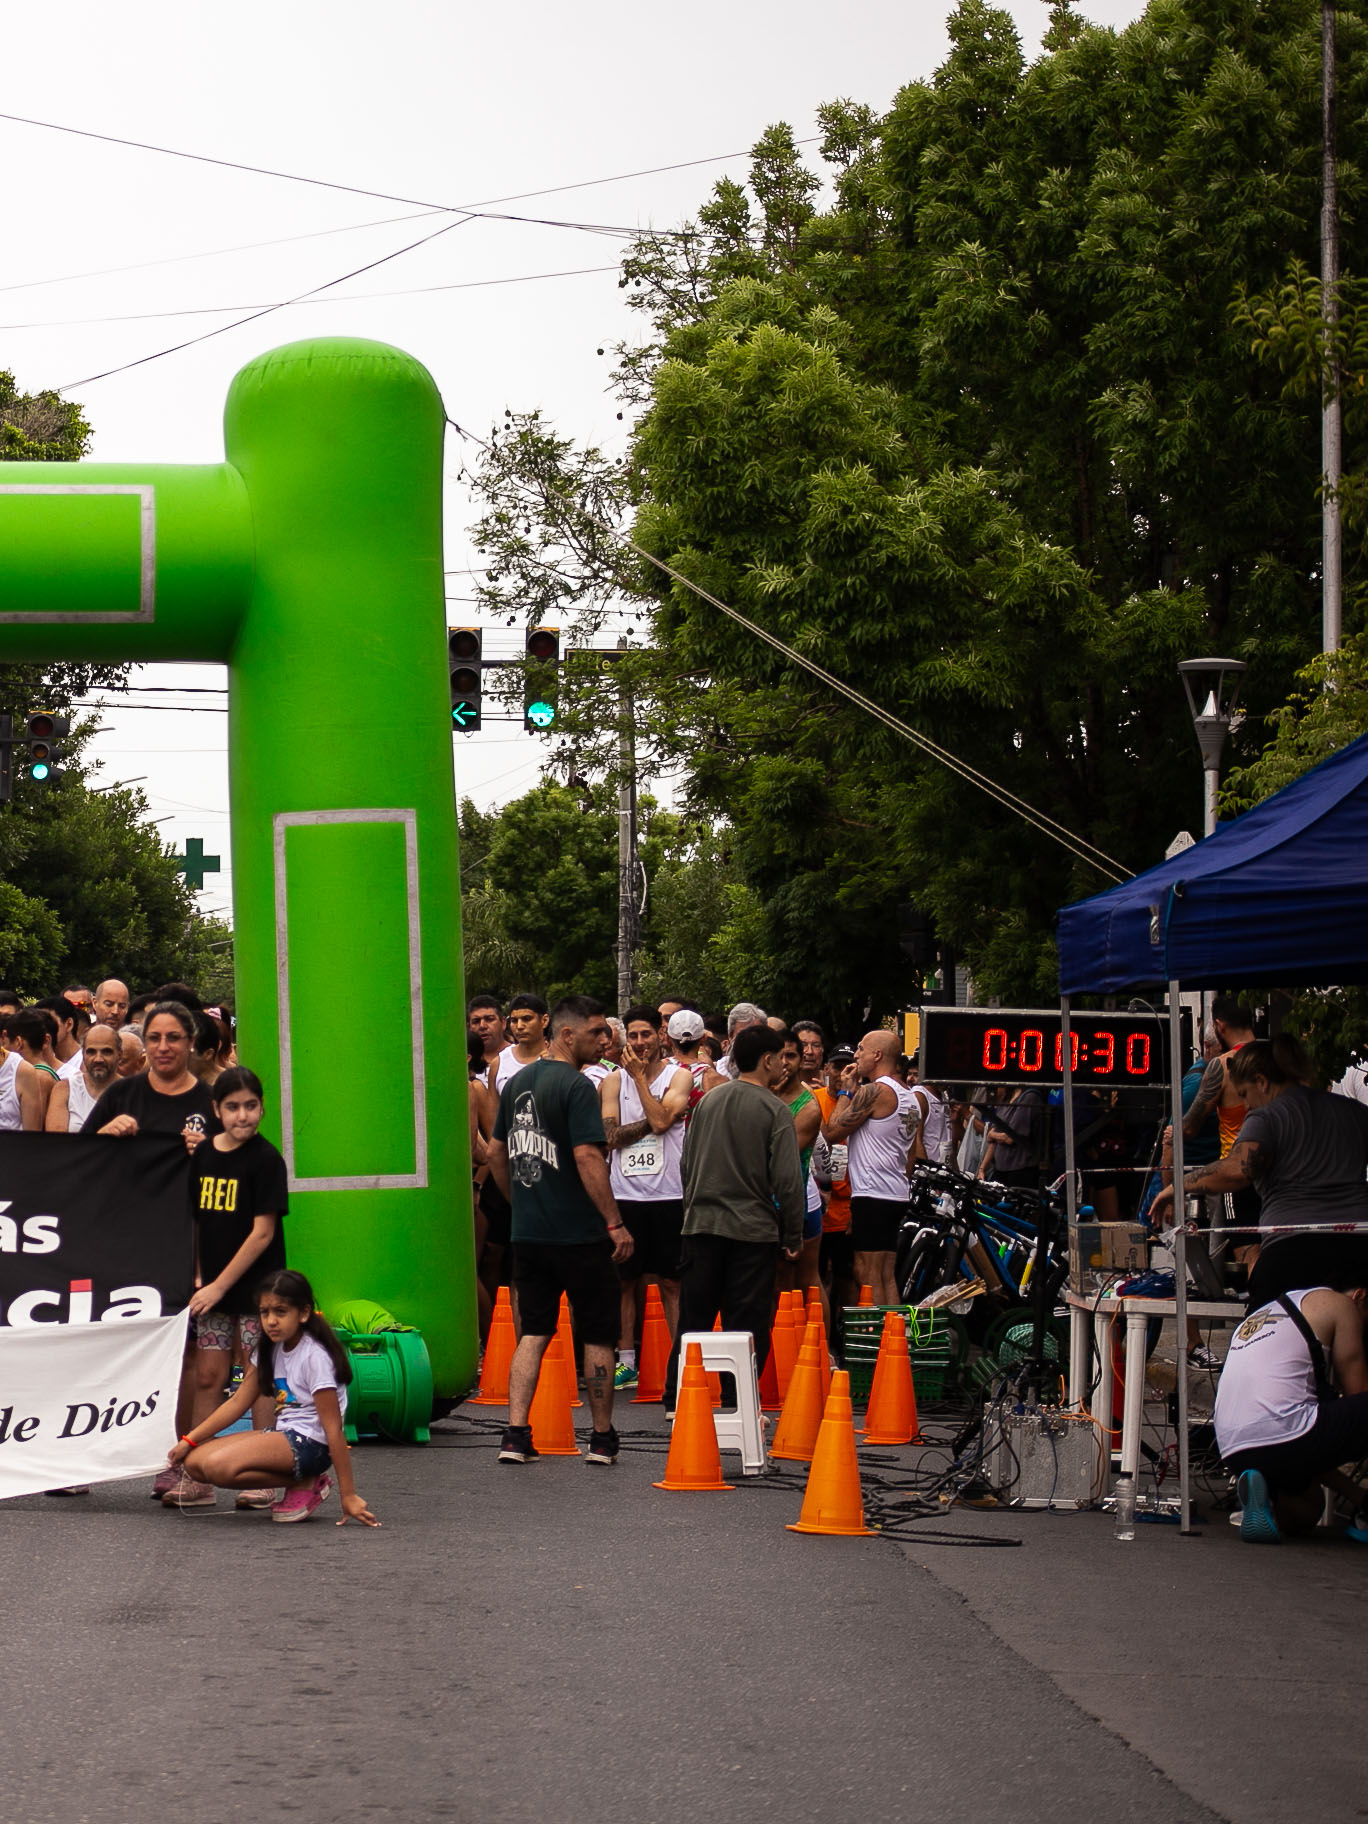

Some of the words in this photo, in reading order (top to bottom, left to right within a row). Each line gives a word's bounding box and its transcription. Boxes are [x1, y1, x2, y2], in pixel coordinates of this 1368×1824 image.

[628, 1152, 655, 1168] 348
[199, 1176, 239, 1212] REO
[57, 1390, 160, 1440] Dios
